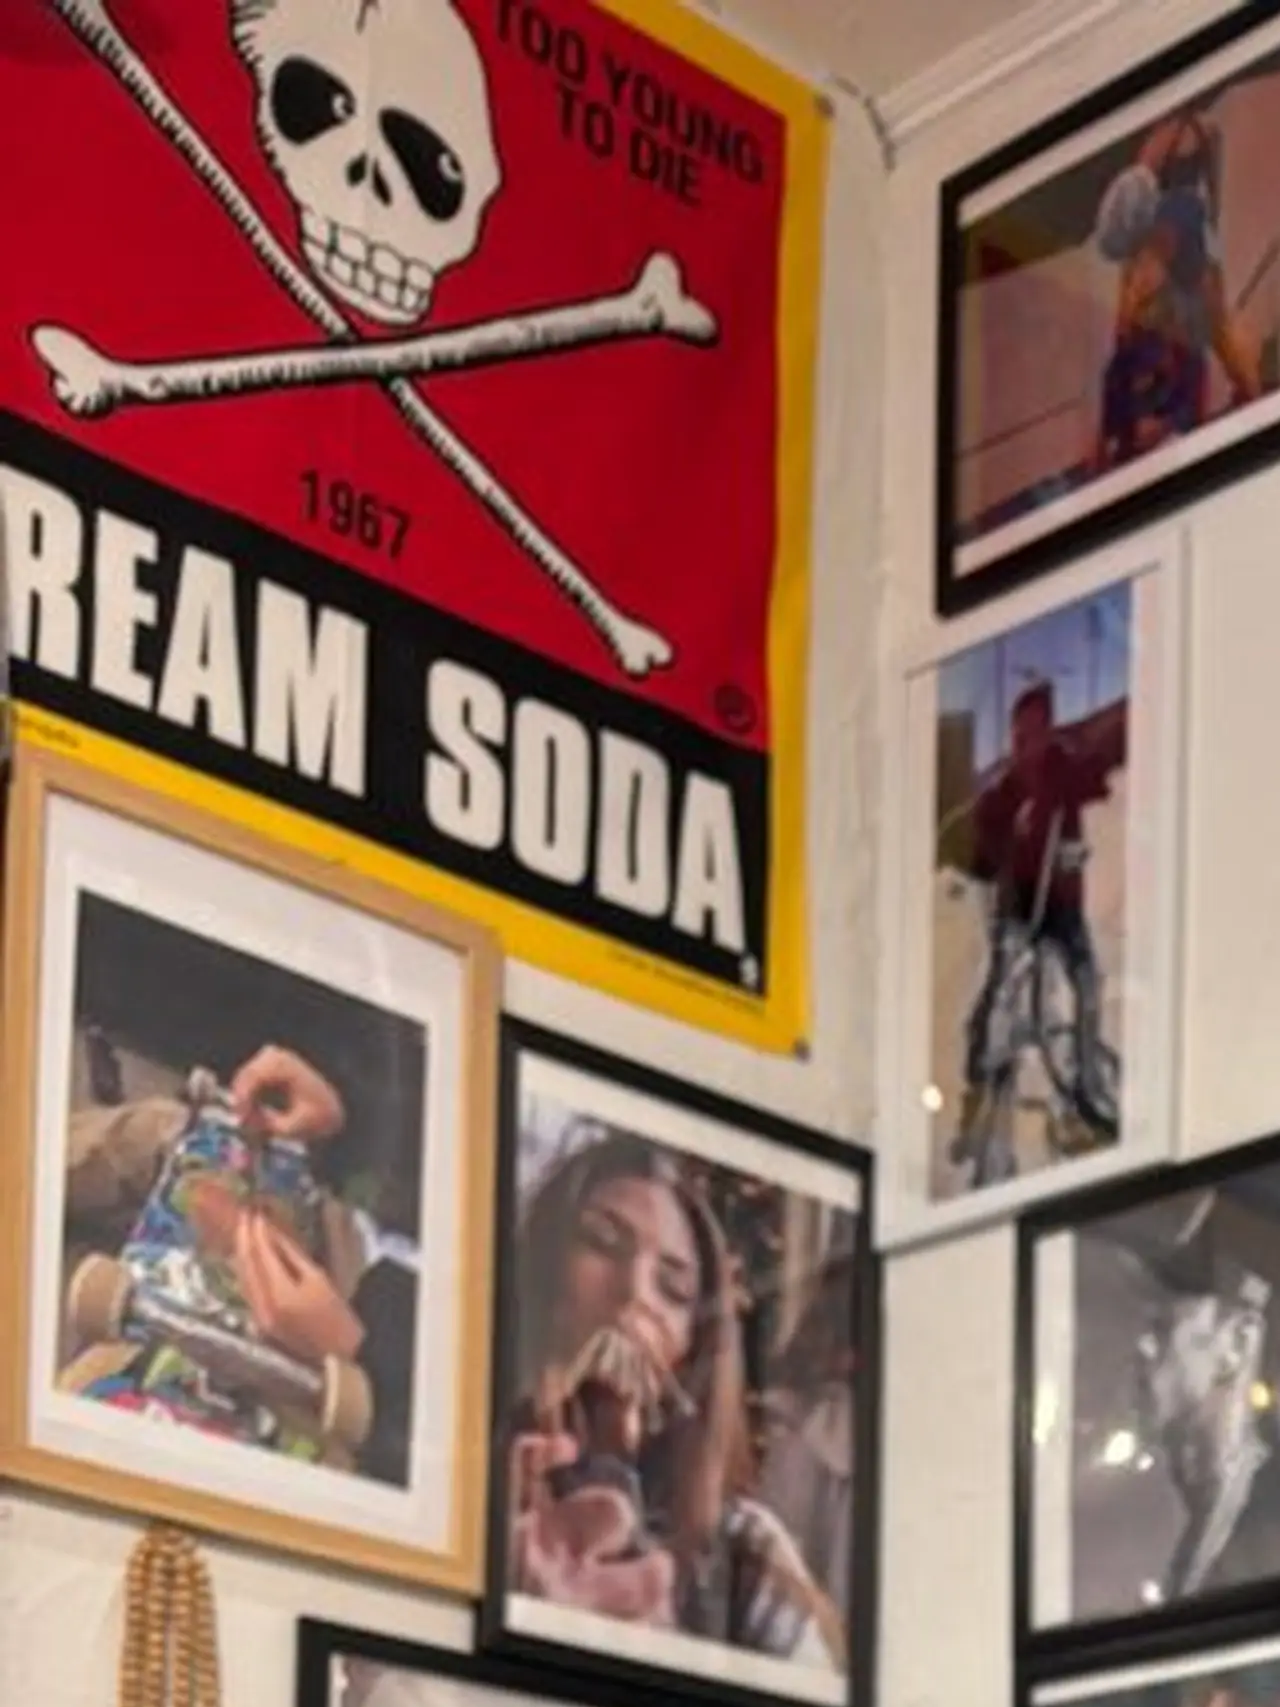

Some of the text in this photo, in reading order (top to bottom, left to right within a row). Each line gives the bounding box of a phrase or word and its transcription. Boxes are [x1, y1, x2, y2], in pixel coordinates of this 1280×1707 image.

[497, 0, 763, 184] TOO YOUNG
[558, 86, 701, 207] TO DIE
[299, 469, 411, 560] 1967
[0, 463, 748, 956] REAM SODA
